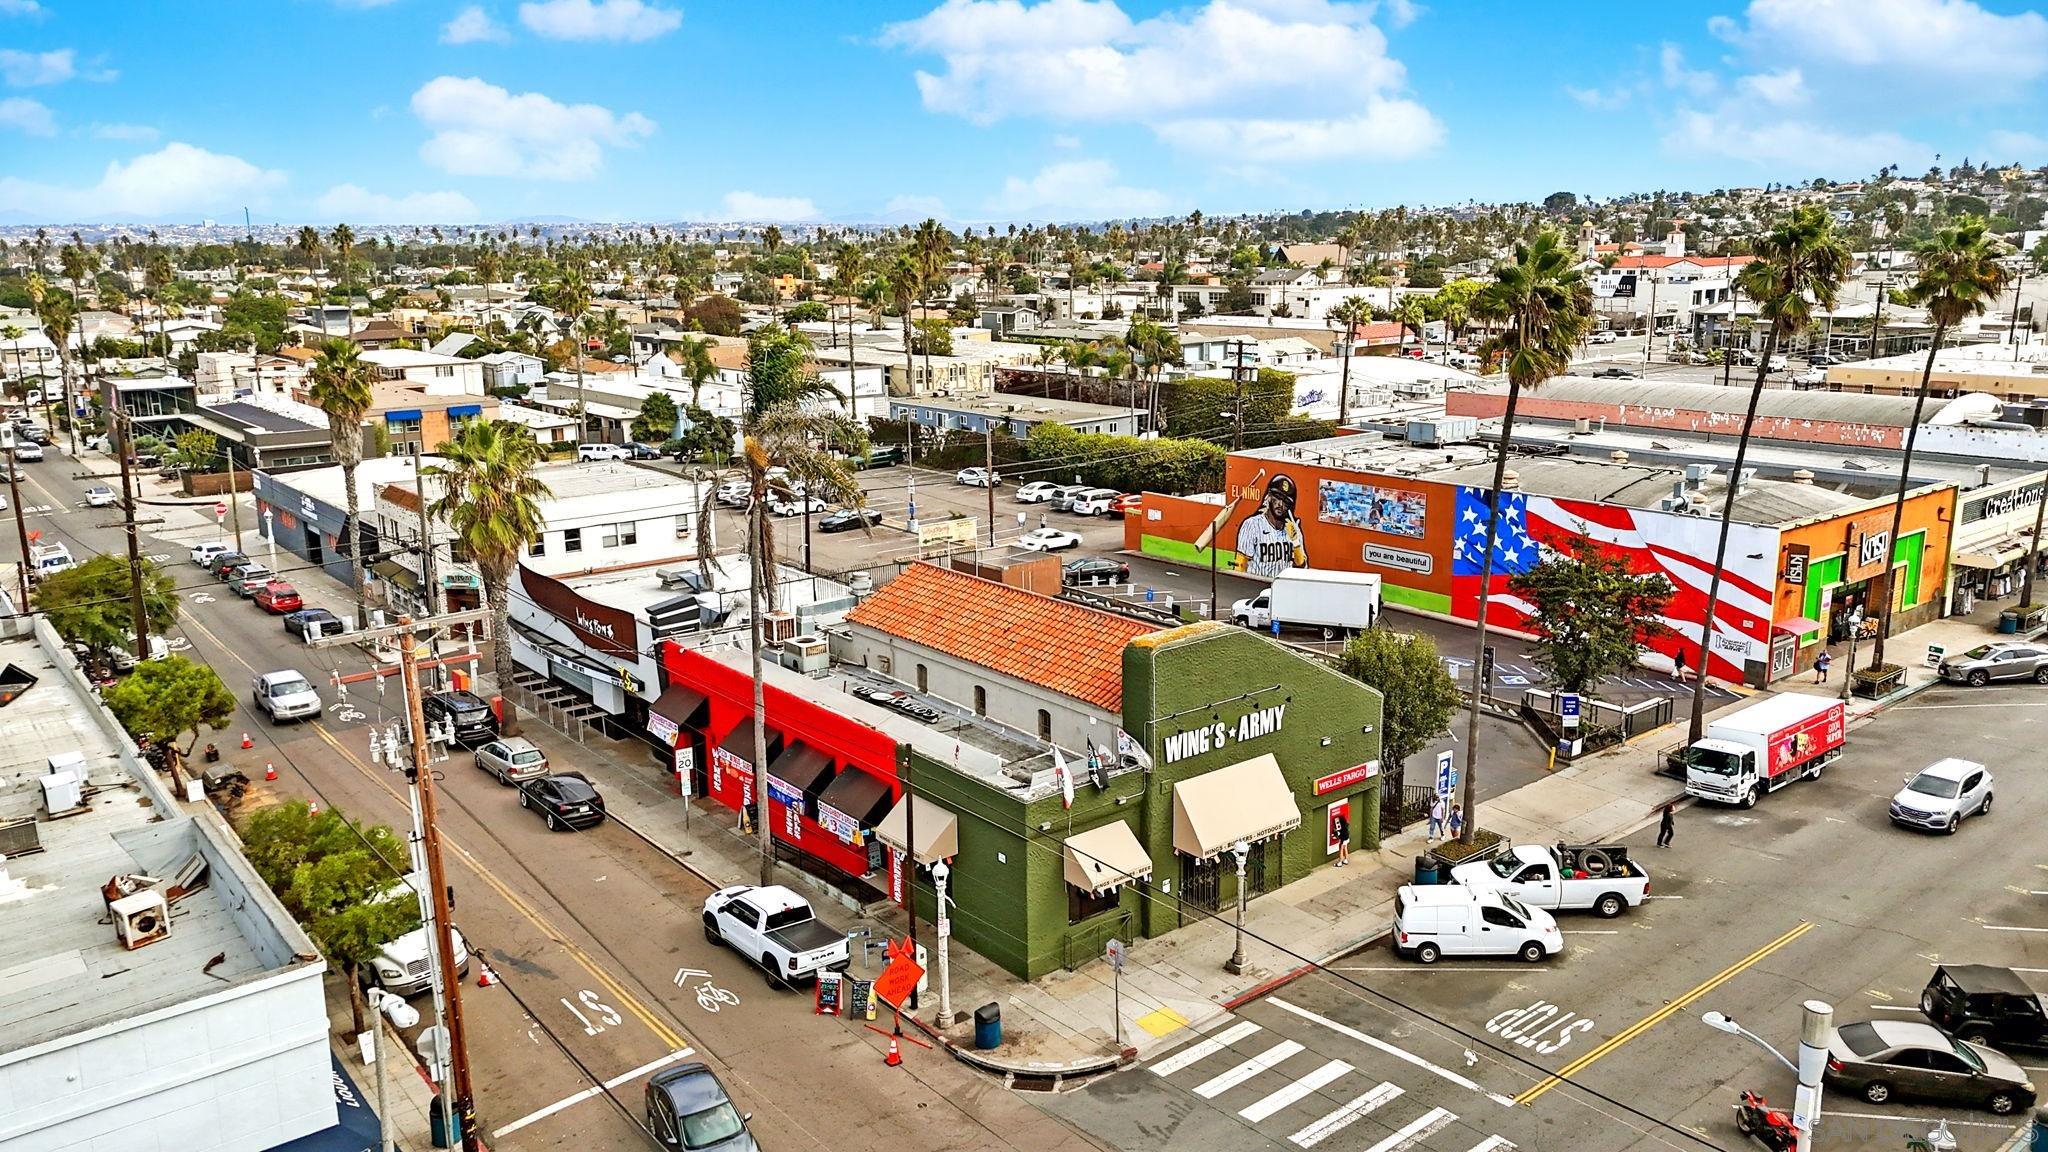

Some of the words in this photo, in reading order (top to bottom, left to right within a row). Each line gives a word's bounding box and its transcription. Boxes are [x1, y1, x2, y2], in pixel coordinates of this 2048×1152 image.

[1232, 484, 1239, 498] EL
[1242, 485, 1260, 501] NIÑO
[1369, 550, 1381, 558] you
[1383, 553, 1394, 561] are
[1396, 554, 1427, 567] beautiful
[1164, 722, 1226, 764] WING'S
[1237, 704, 1286, 742] ARMY
[678, 759, 692, 769] 20
[1319, 777, 1342, 791] WELLS
[1343, 769, 1365, 783] FARGO
[1204, 846, 1223, 856] WINGS
[1256, 823, 1282, 837] HOTDOGS
[1286, 817, 1300, 827] BEER
[1139, 865, 1152, 874] BEER
[812, 951, 835, 961] RAM
[889, 963, 909, 976] ROAD
[889, 974, 909, 986] WORK
[887, 984, 911, 996] AHEAD
[1485, 1000, 1595, 1054] STOP
